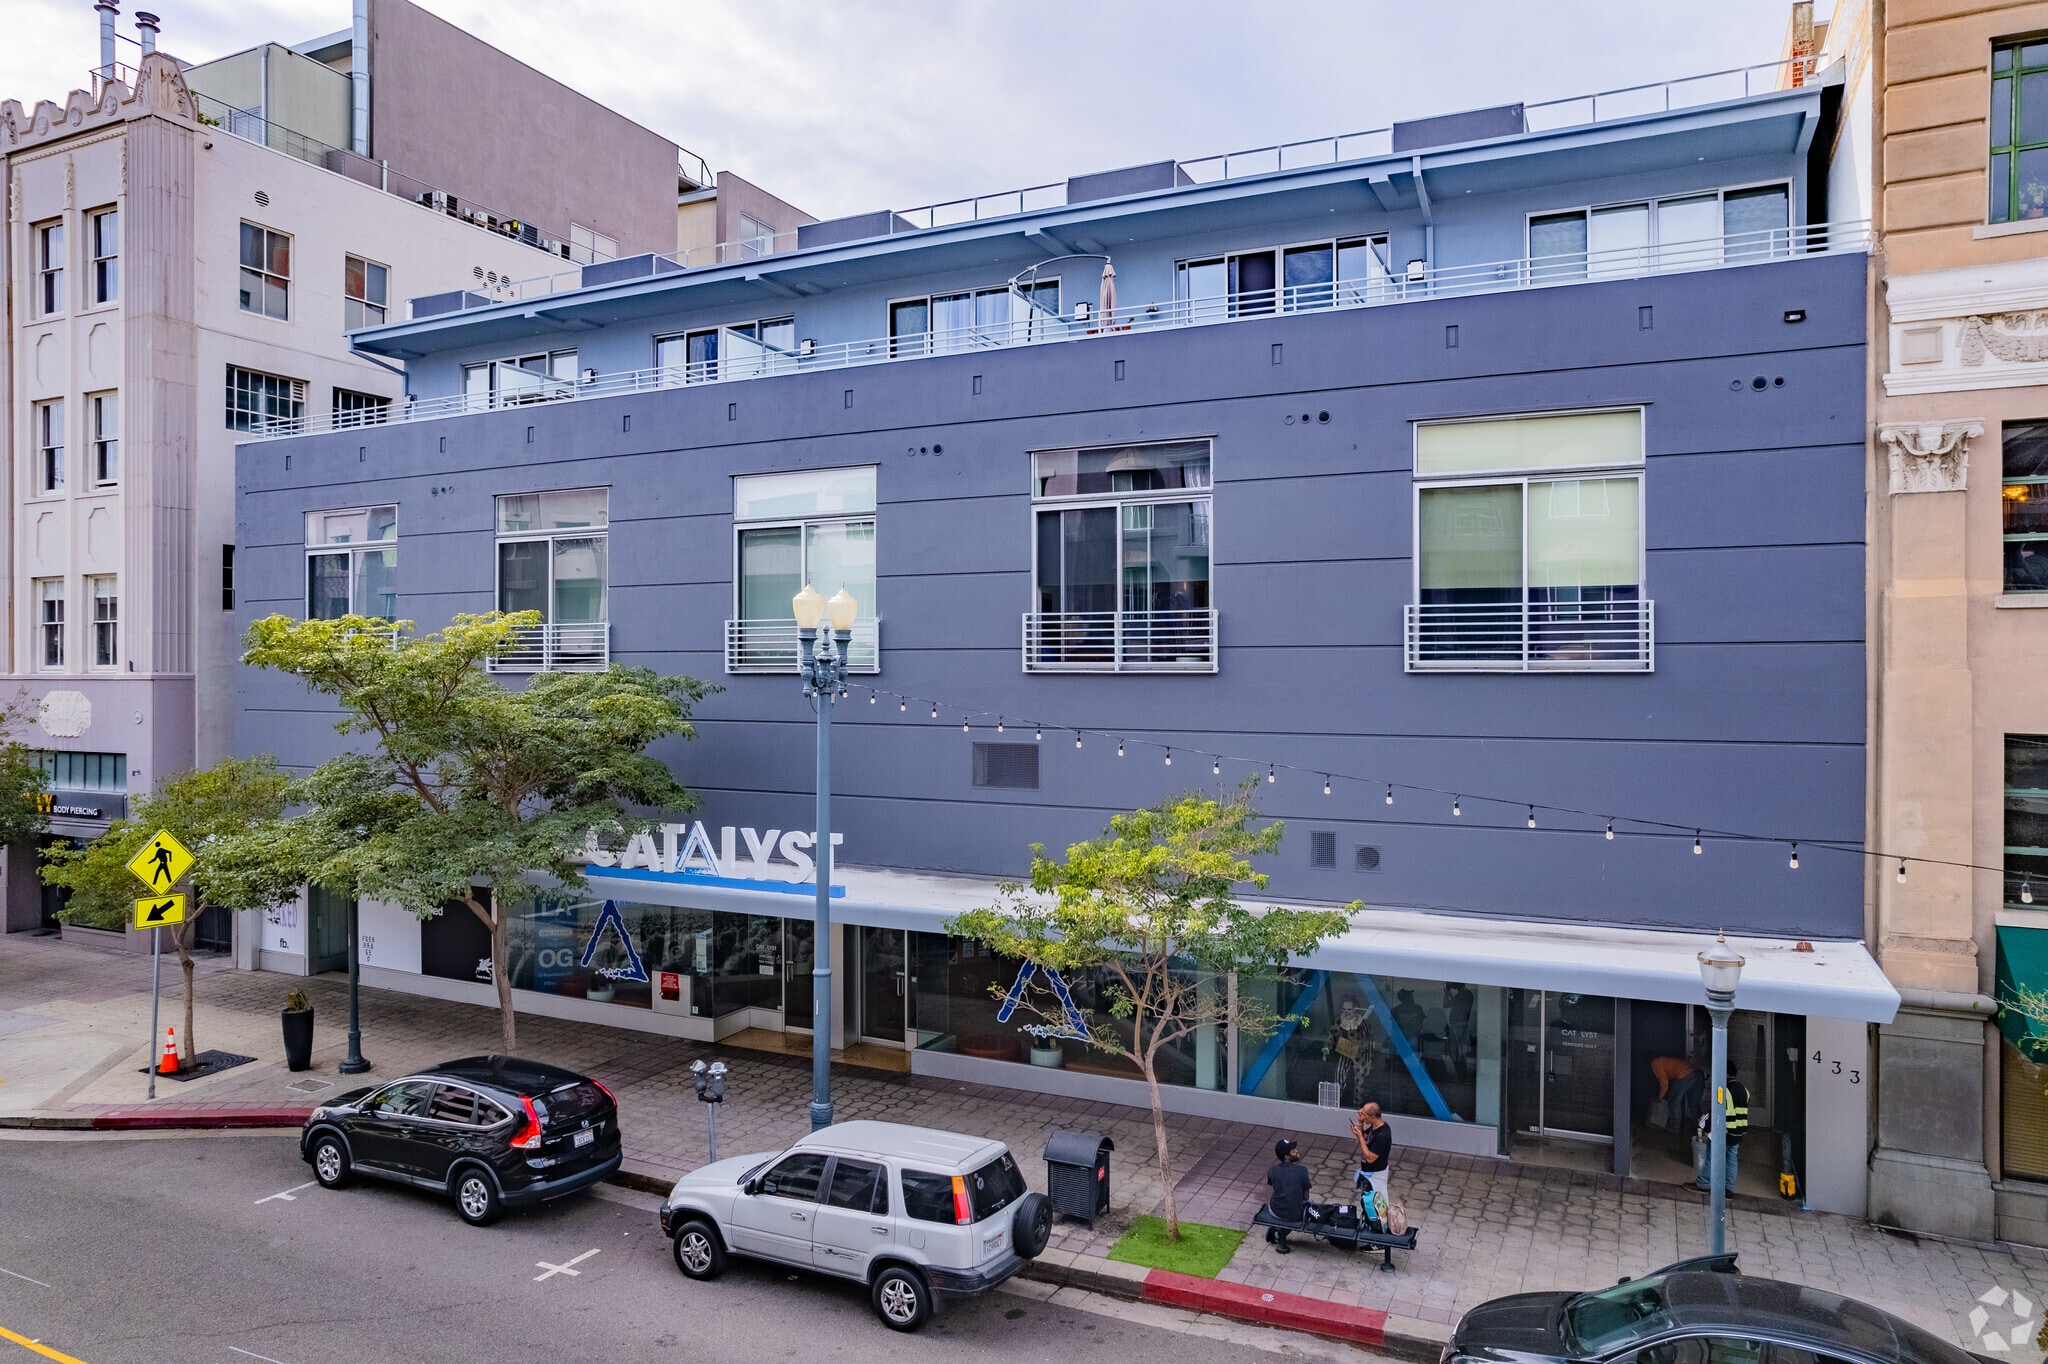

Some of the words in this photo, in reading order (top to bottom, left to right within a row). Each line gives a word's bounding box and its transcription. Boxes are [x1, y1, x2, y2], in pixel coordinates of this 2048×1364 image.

[53, 805, 69, 814] BODY
[70, 806, 98, 816] PIERCING
[585, 819, 844, 885] CATALYST
[538, 948, 574, 968] OG
